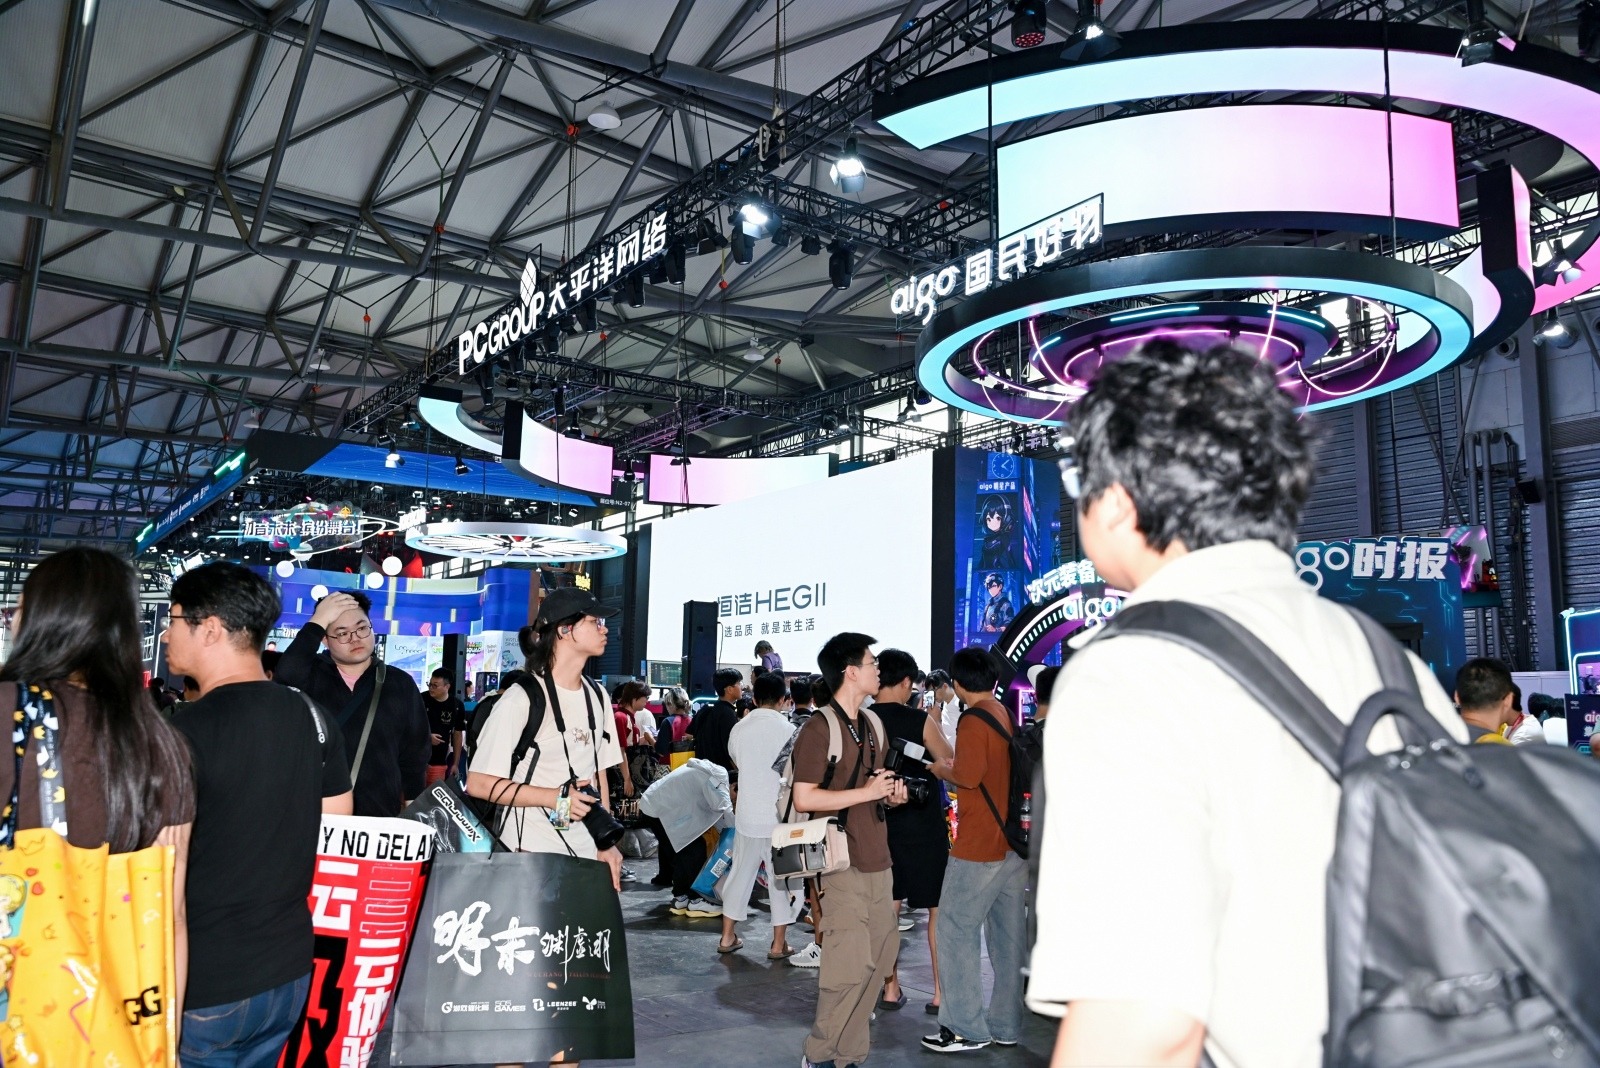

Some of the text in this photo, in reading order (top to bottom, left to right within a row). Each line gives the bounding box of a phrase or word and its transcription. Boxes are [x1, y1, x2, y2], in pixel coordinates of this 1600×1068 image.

[890, 201, 1102, 325] aigo 国民好物
[458, 211, 668, 375] PCGROUP 太平洋网络
[1026, 558, 1107, 605] 次元装备
[724, 617, 815, 638] 选品质 就是选生活
[340, 829, 370, 858] NO
[494, 1005, 526, 1013] GAMES
